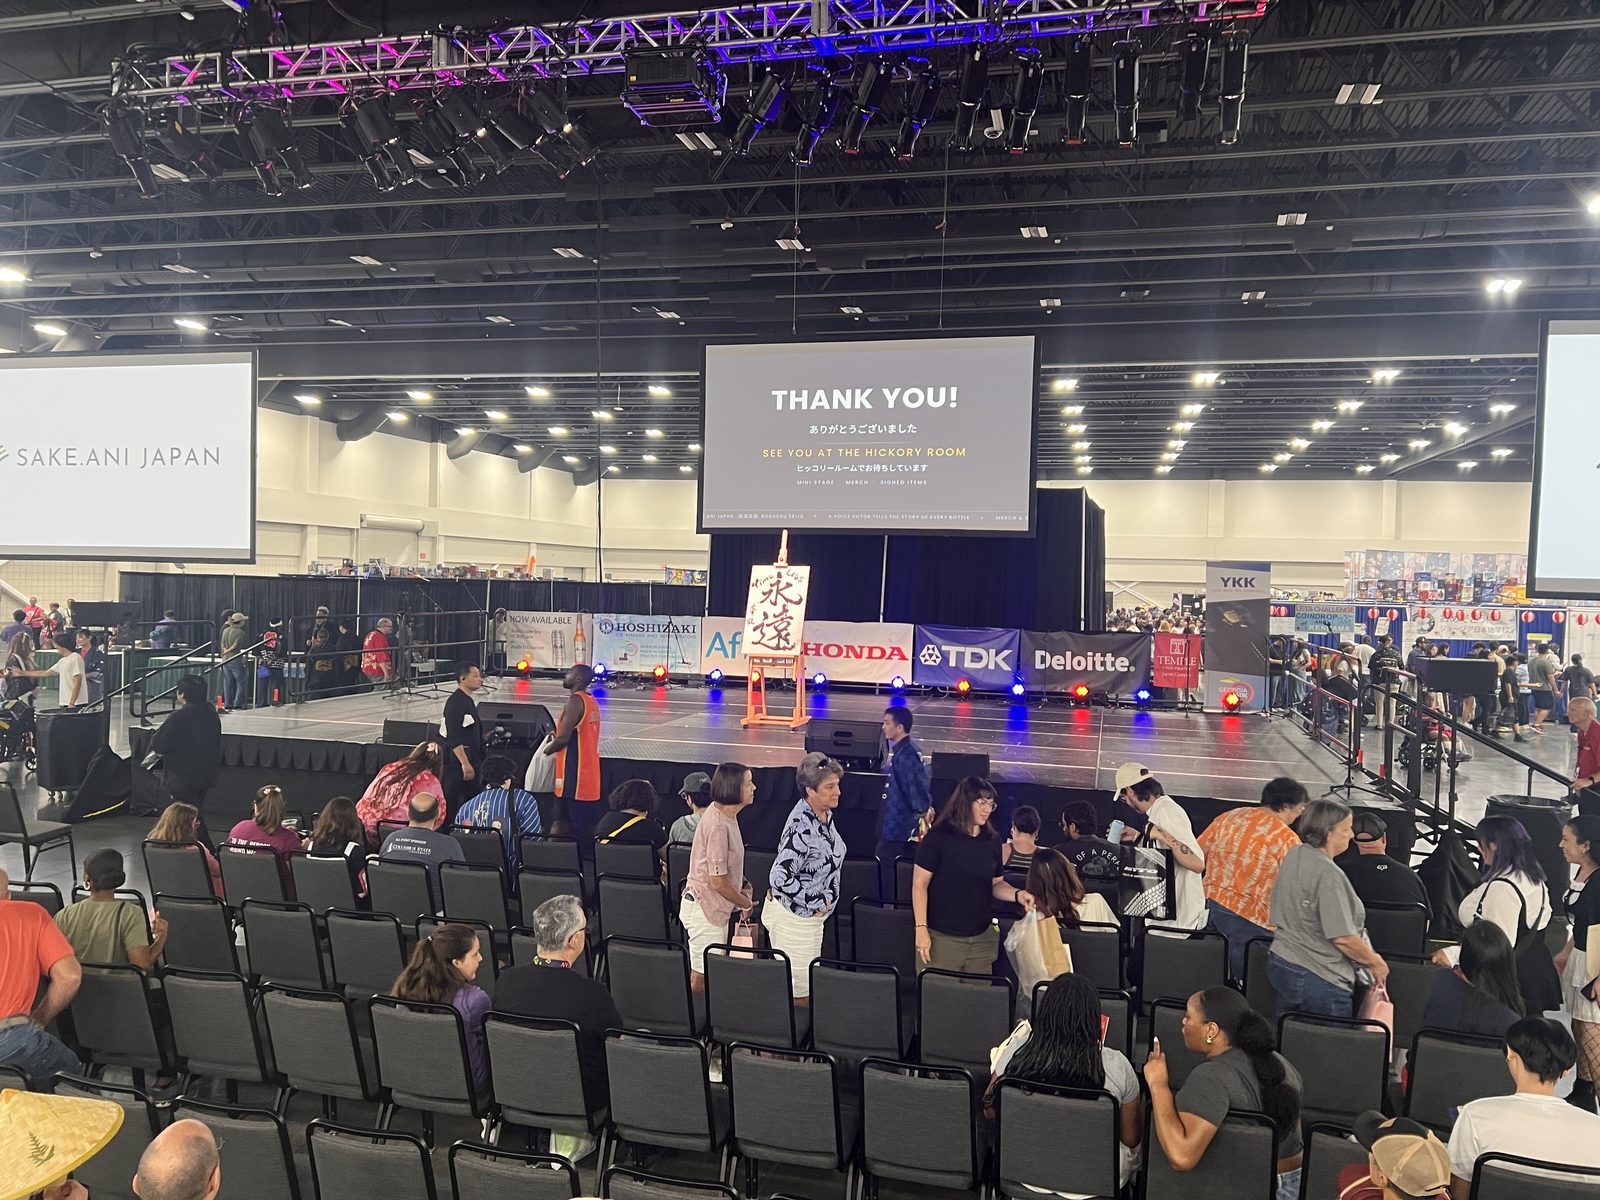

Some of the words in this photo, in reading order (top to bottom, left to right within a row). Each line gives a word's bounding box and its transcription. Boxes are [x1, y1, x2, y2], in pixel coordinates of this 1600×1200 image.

[771, 388, 874, 411] THANK
[882, 386, 958, 409] YOU!
[809, 423, 918, 435] ありがとうございました
[16, 447, 129, 467] SAKE.ANI
[140, 446, 220, 469] JAPAN
[762, 449, 783, 458] SEE
[788, 449, 813, 458] YOU
[818, 448, 833, 458] AT
[838, 447, 860, 457] THE
[865, 447, 922, 457] HICKORY
[927, 447, 966, 457] ROOM
[797, 464, 929, 473] ヒッコリールームでお待ちしています
[1220, 576, 1256, 588] YKK
[509, 615, 529, 624] NOW
[530, 616, 572, 624] AVAILABLE
[616, 622, 697, 634] HOSHIZAKI
[803, 642, 909, 661] HONDA
[941, 645, 1013, 671] TDK
[1076, 851, 1087, 861] OF
[1091, 848, 1098, 856] A
